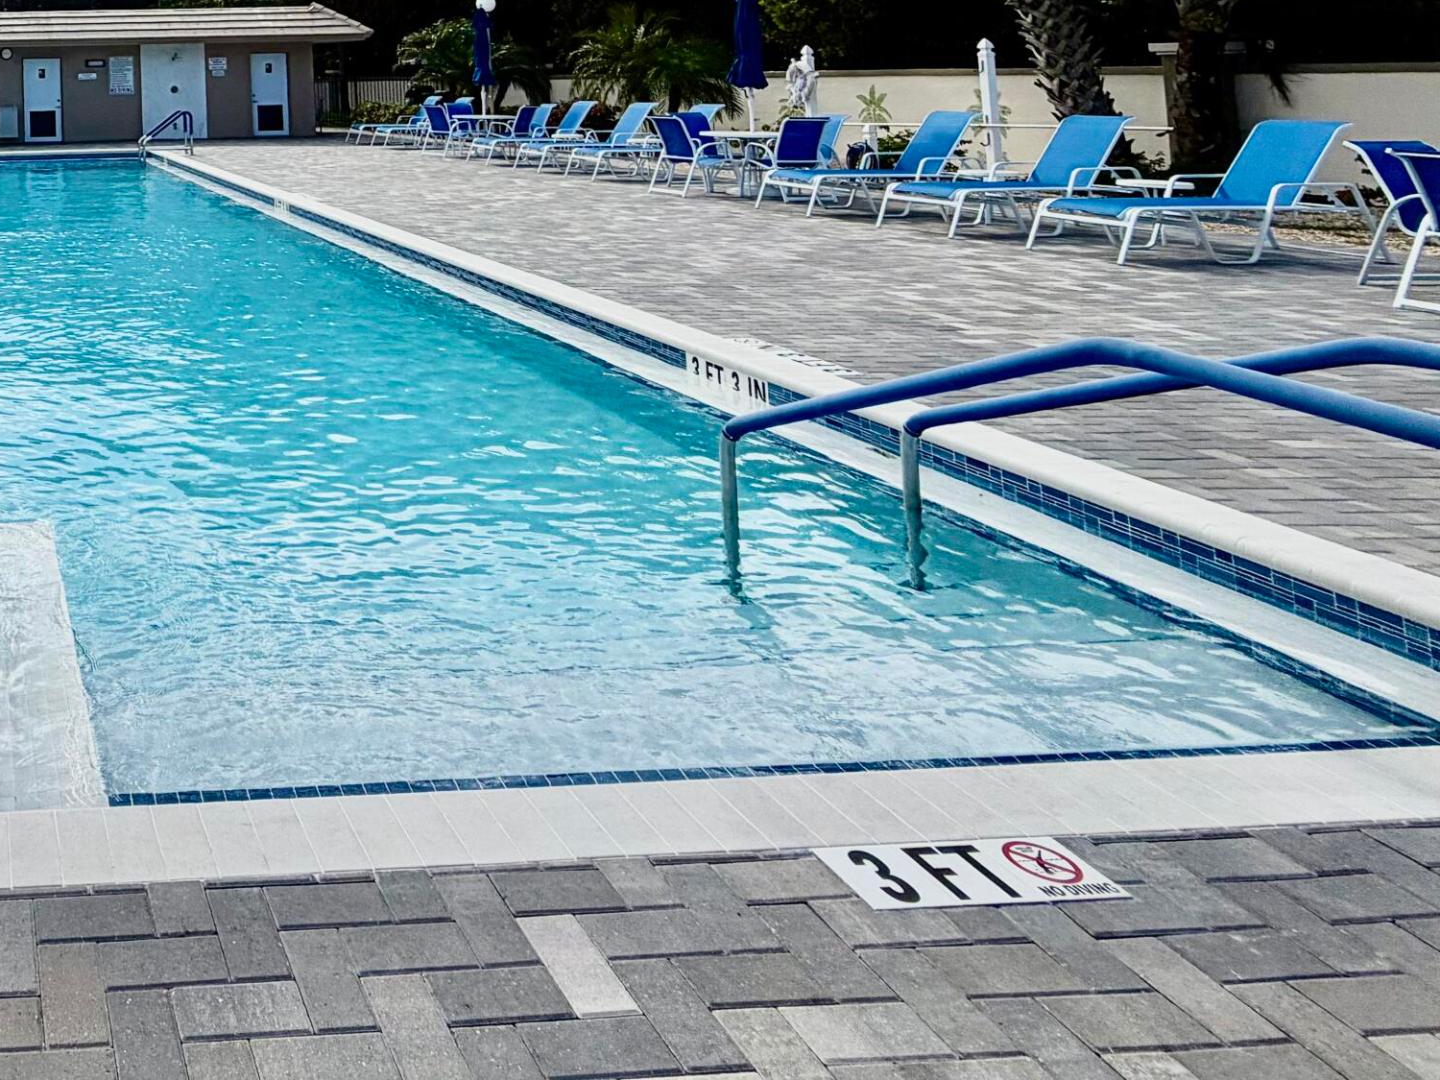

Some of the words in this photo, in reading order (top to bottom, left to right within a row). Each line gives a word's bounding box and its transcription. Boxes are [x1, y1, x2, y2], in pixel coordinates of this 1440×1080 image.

[691, 356, 701, 375] 3
[705, 361, 724, 385] FT
[731, 371, 741, 391] 3
[748, 377, 766, 402] IN
[847, 849, 921, 903] 3
[900, 844, 1022, 900] FT
[1038, 885, 1067, 897] NO
[1063, 882, 1120, 896] DIVING
